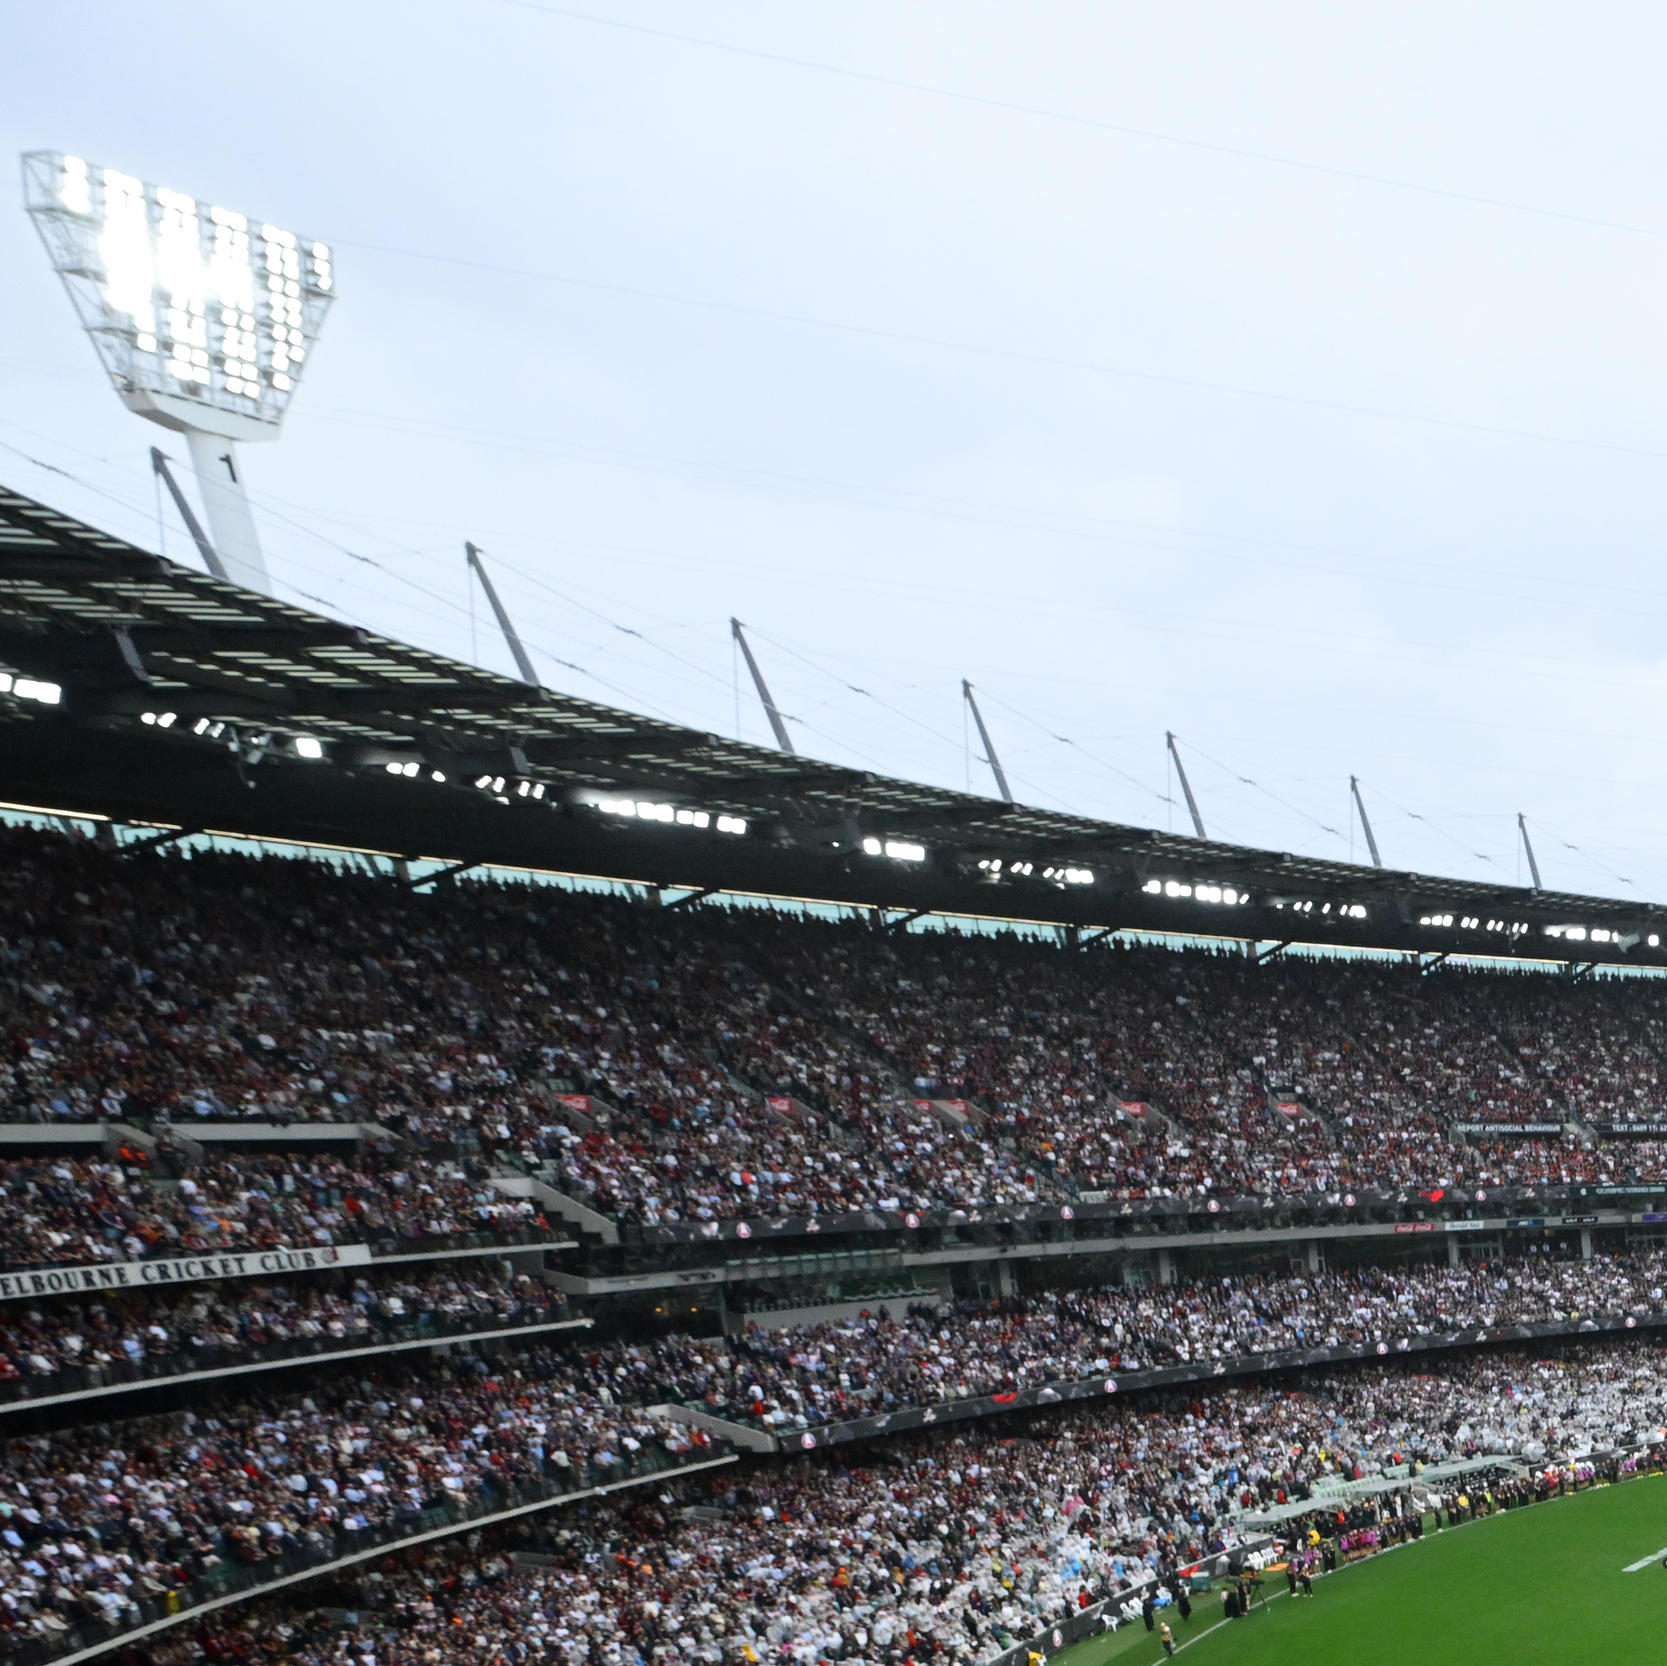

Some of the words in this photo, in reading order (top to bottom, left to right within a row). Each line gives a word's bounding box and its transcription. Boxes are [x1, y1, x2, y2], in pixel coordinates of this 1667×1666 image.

[218, 453, 238, 483] 1
[142, 1256, 248, 1284] CRICKET
[260, 1251, 317, 1273] CLUB
